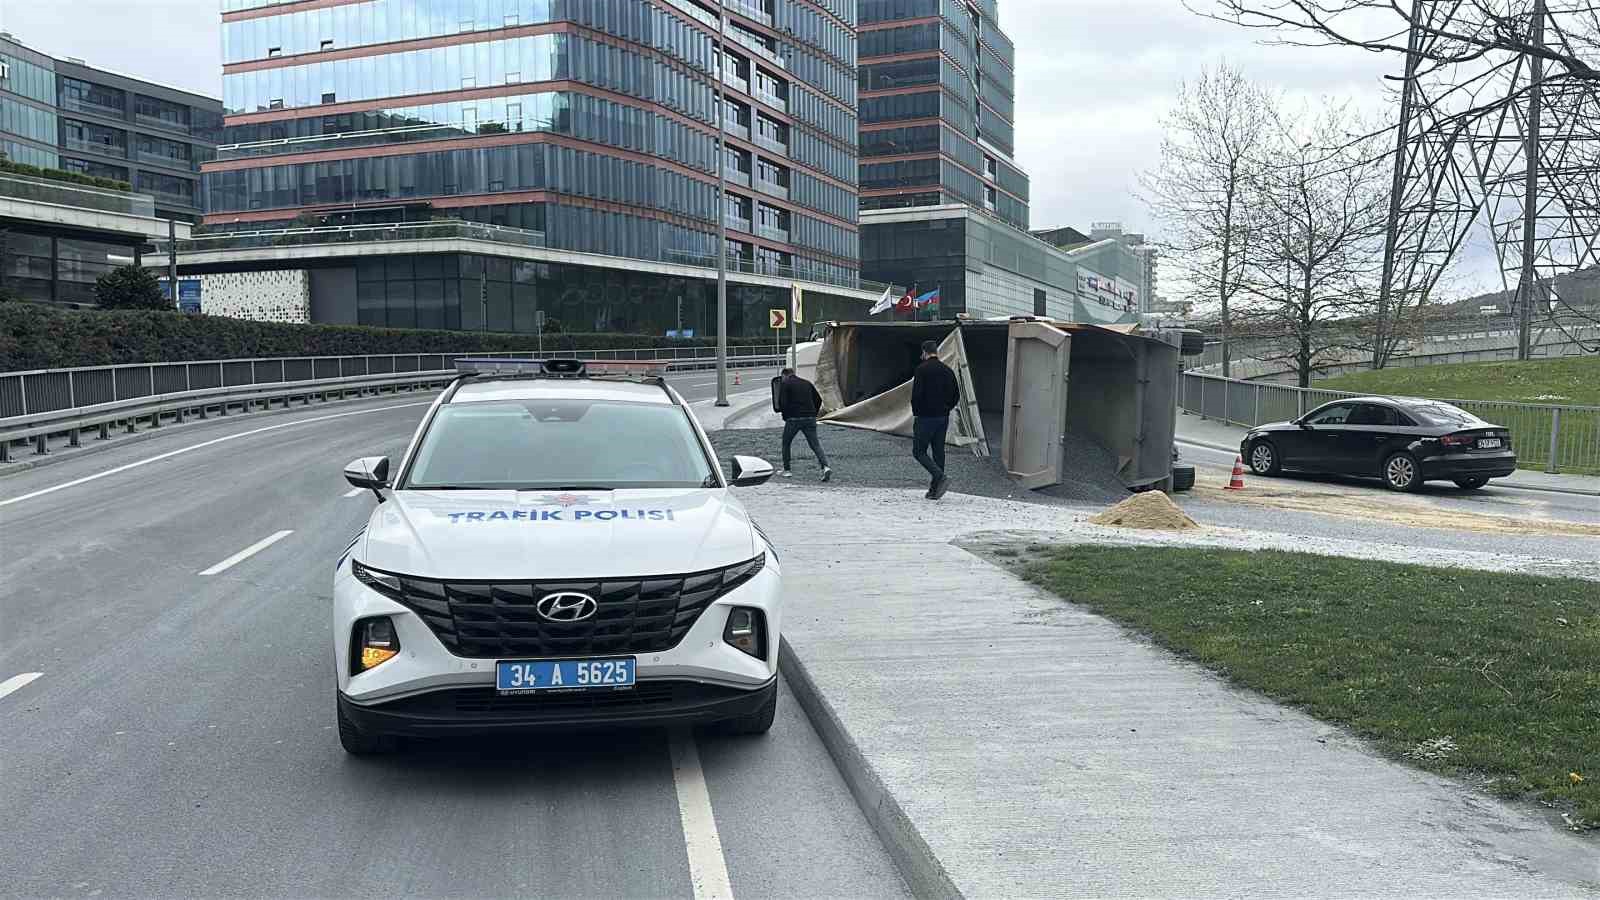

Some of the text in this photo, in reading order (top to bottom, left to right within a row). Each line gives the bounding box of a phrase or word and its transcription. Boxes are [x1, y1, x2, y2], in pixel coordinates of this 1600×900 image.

[511, 661, 627, 686] 34 A 5625
